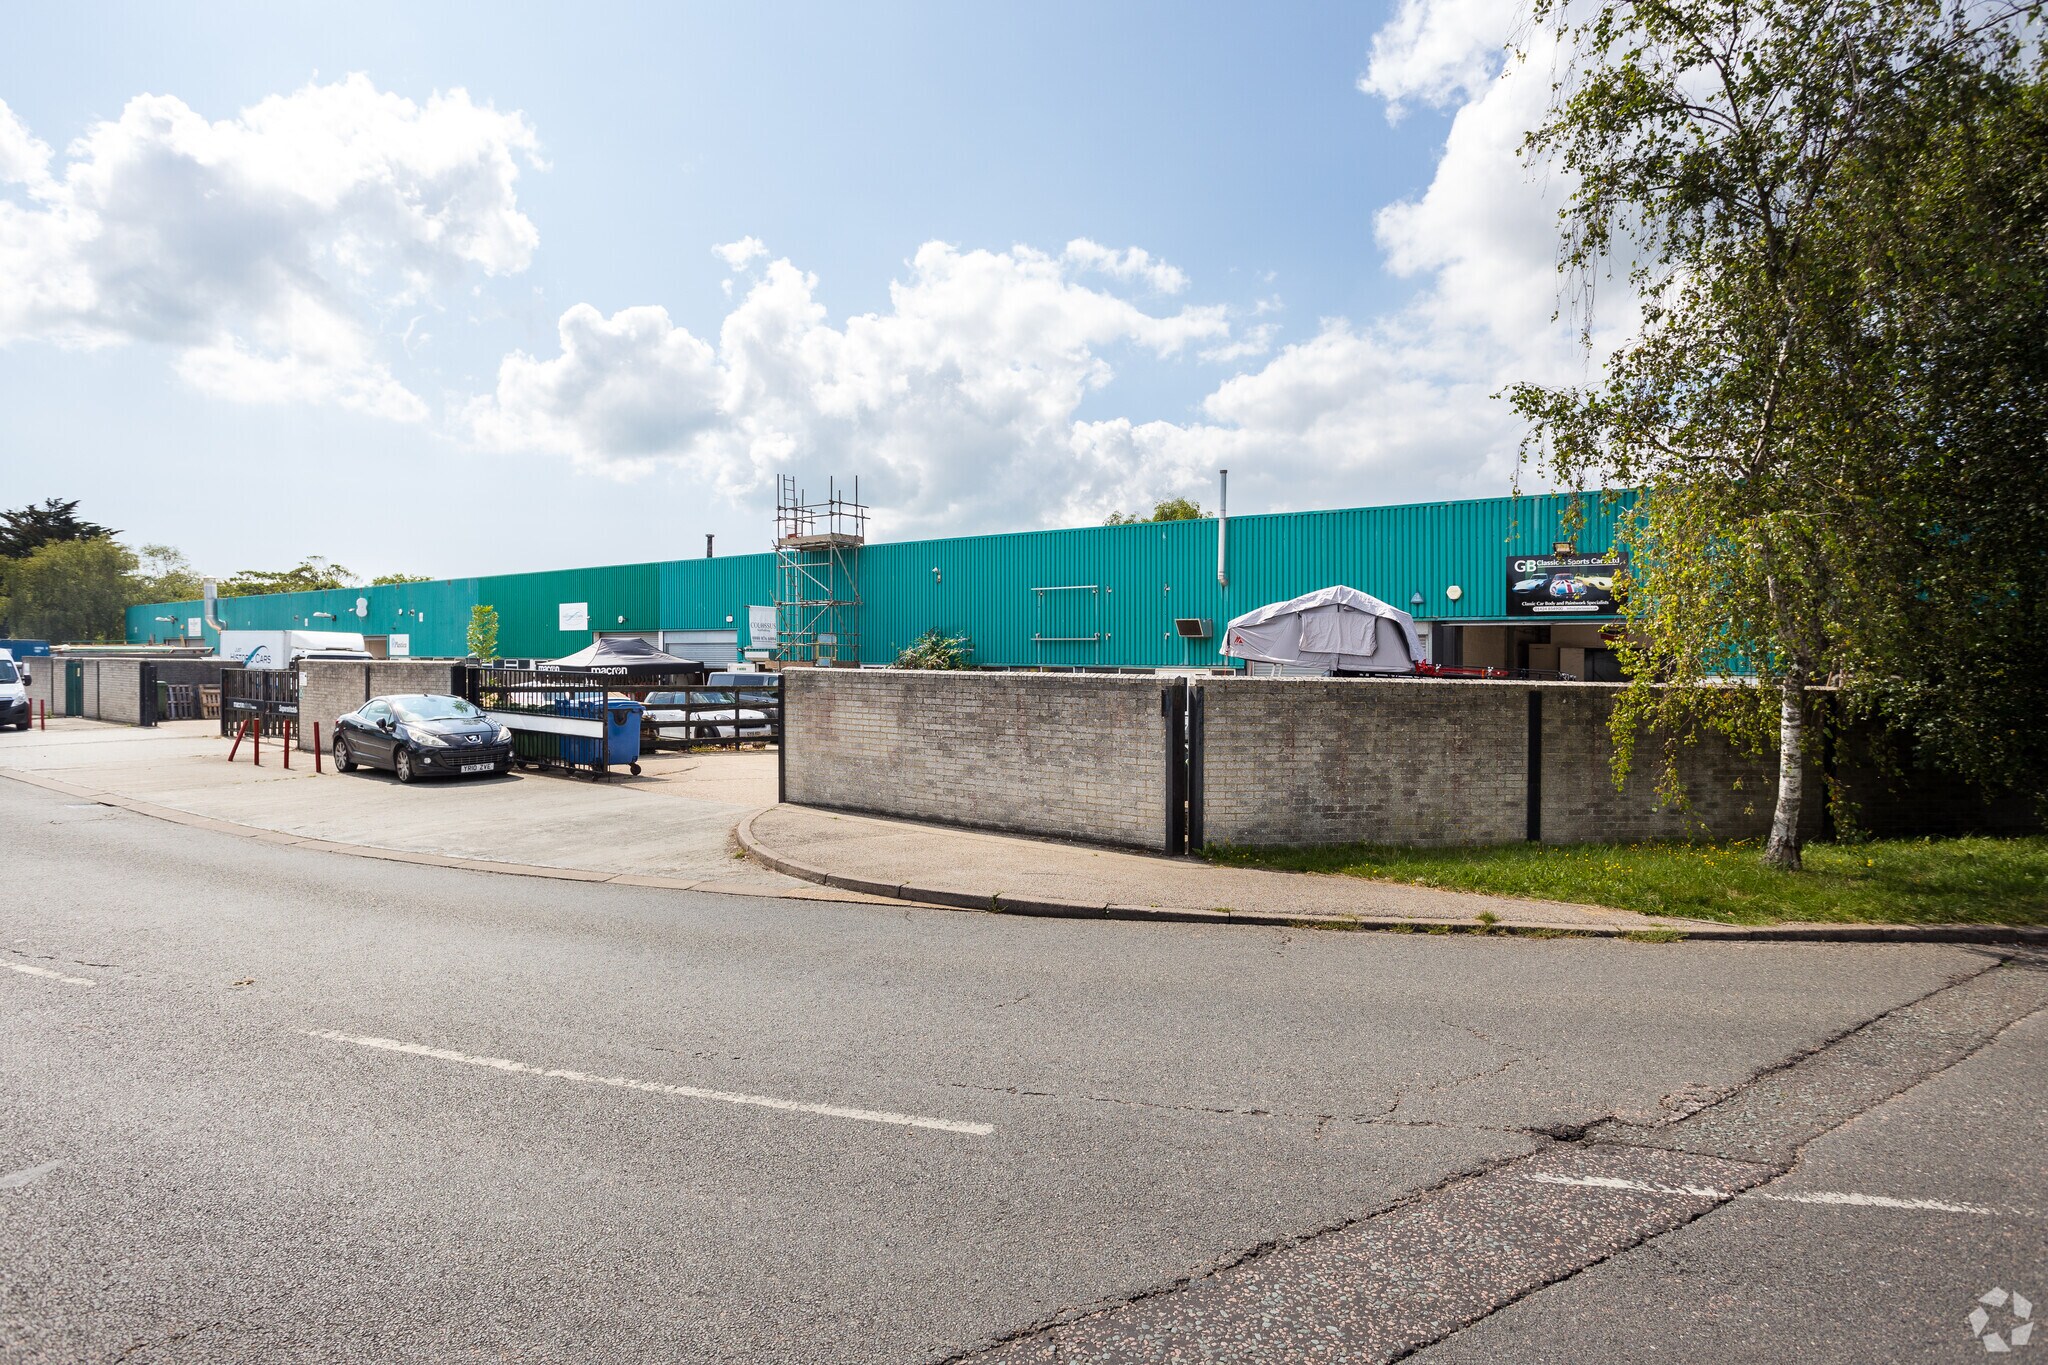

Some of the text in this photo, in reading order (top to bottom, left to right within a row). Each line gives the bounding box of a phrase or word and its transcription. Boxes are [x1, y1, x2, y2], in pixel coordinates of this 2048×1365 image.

[1514, 559, 1537, 572] GB
[1567, 557, 1590, 566] Sports
[1591, 556, 1609, 564] Car
[230, 652, 272, 664] HISTORC CARS
[591, 667, 627, 675] macron
